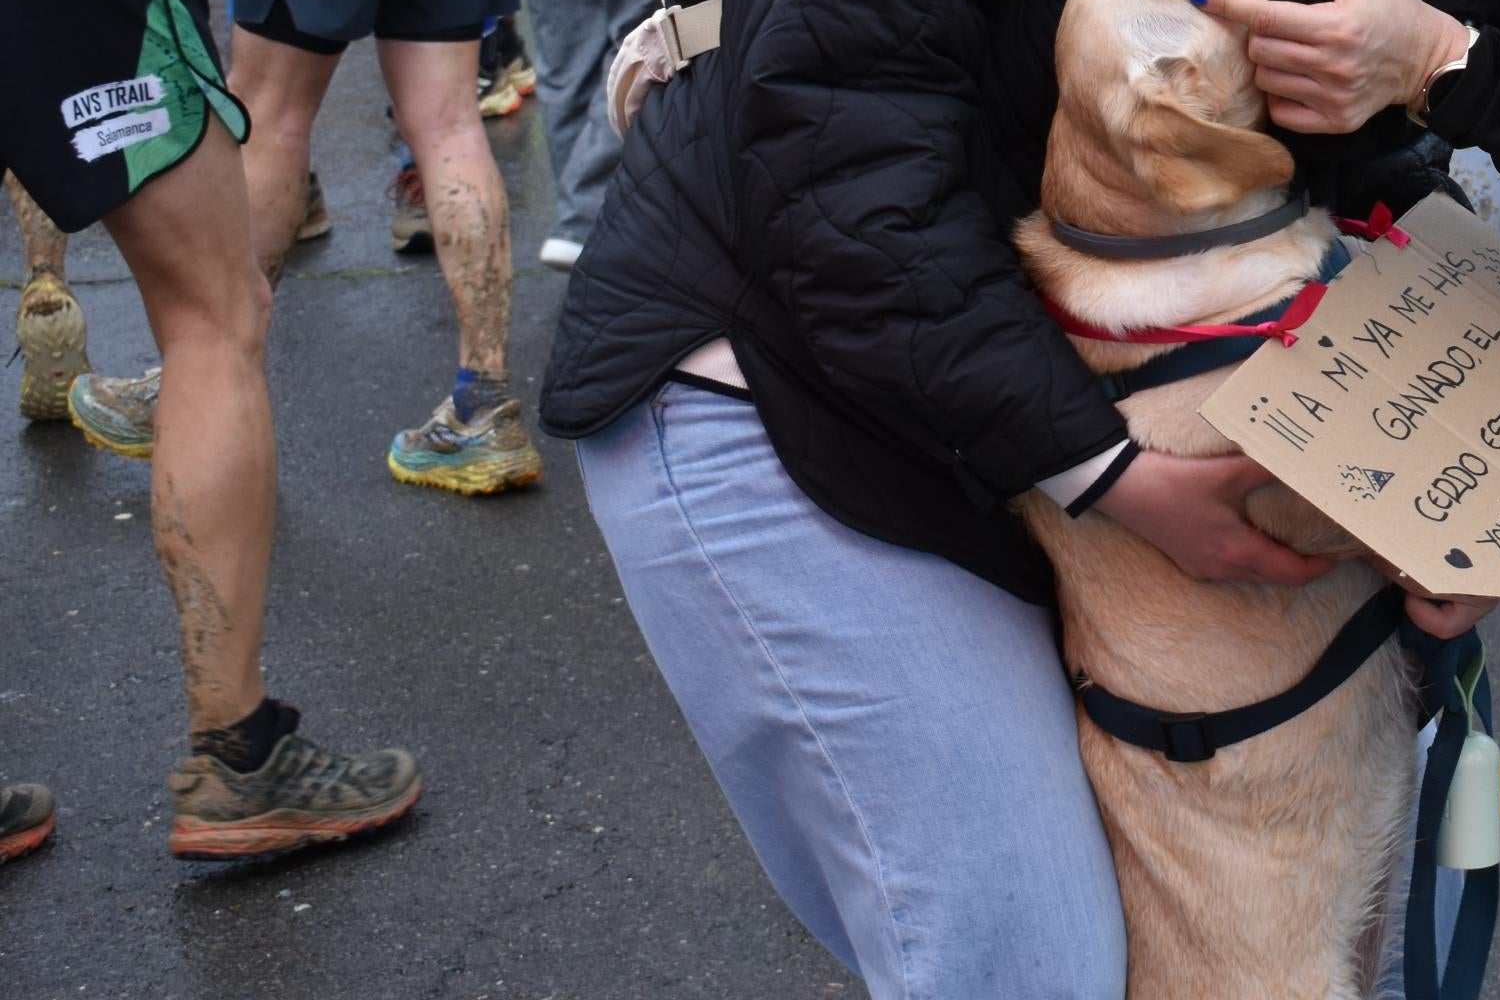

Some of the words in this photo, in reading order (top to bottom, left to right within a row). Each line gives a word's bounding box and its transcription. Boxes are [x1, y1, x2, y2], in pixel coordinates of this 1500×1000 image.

[73, 92, 102, 121] AVS
[105, 82, 155, 109] TRAIL
[97, 121, 153, 147] Salamanca
[1321, 351, 1369, 393] MI
[1353, 318, 1404, 359] YA
[1389, 286, 1436, 325] ME
[1418, 251, 1477, 297] HAS
[1414, 452, 1489, 522] CERDO
